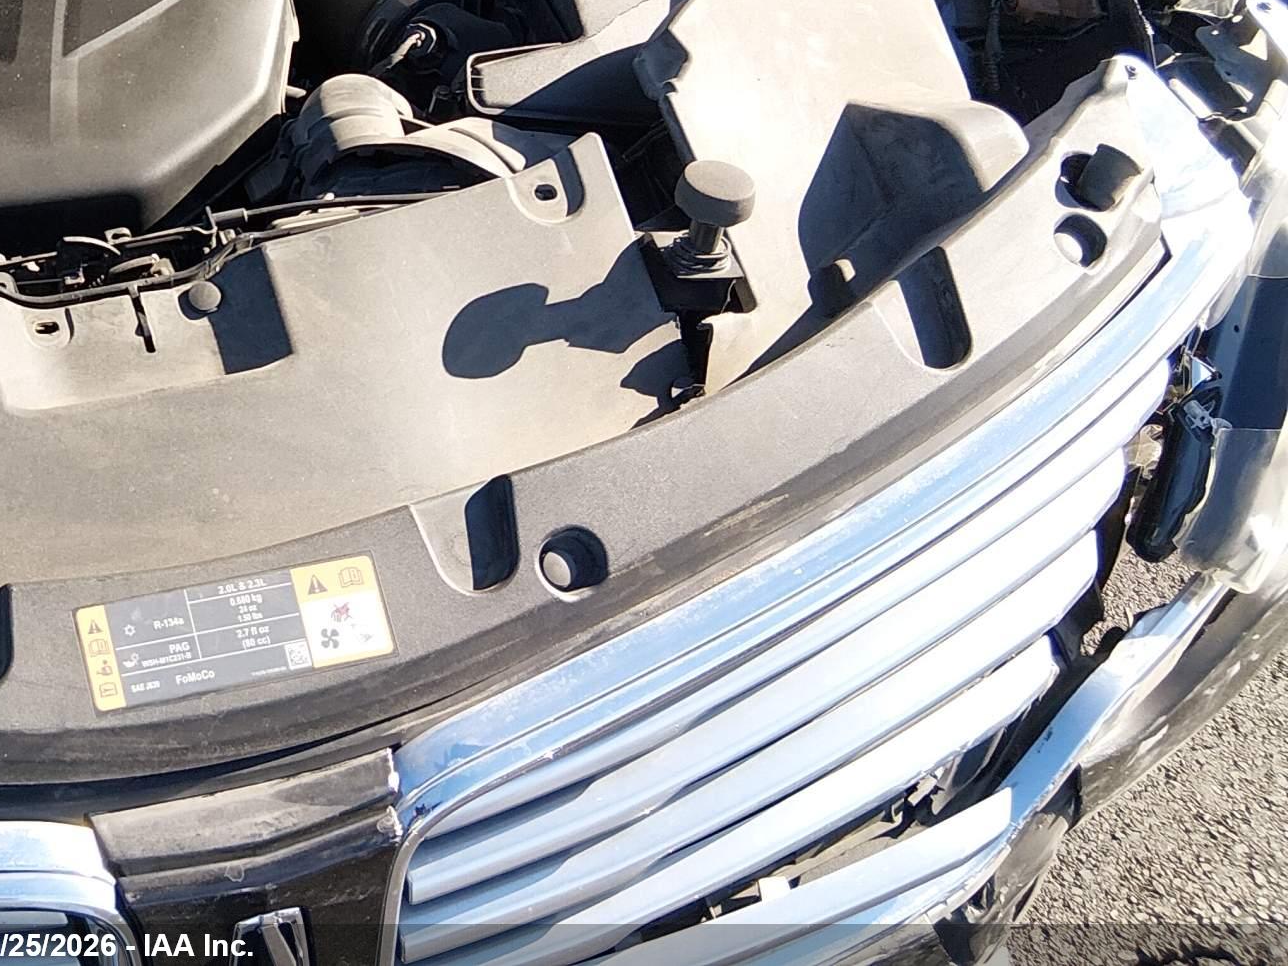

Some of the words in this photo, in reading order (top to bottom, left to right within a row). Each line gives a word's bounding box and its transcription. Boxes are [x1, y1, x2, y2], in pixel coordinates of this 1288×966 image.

[217, 584, 238, 595] 2.0L
[247, 577, 268, 589] 2.3L
[251, 593, 263, 604] kg
[248, 604, 258, 612] oz
[153, 617, 185, 630] R-134a
[236, 627, 249, 638] 2.7
[258, 625, 270, 634] oz
[257, 635, 271, 645] cc)
[168, 641, 190, 654] PAG
[175, 669, 216, 685] FoMoCo
